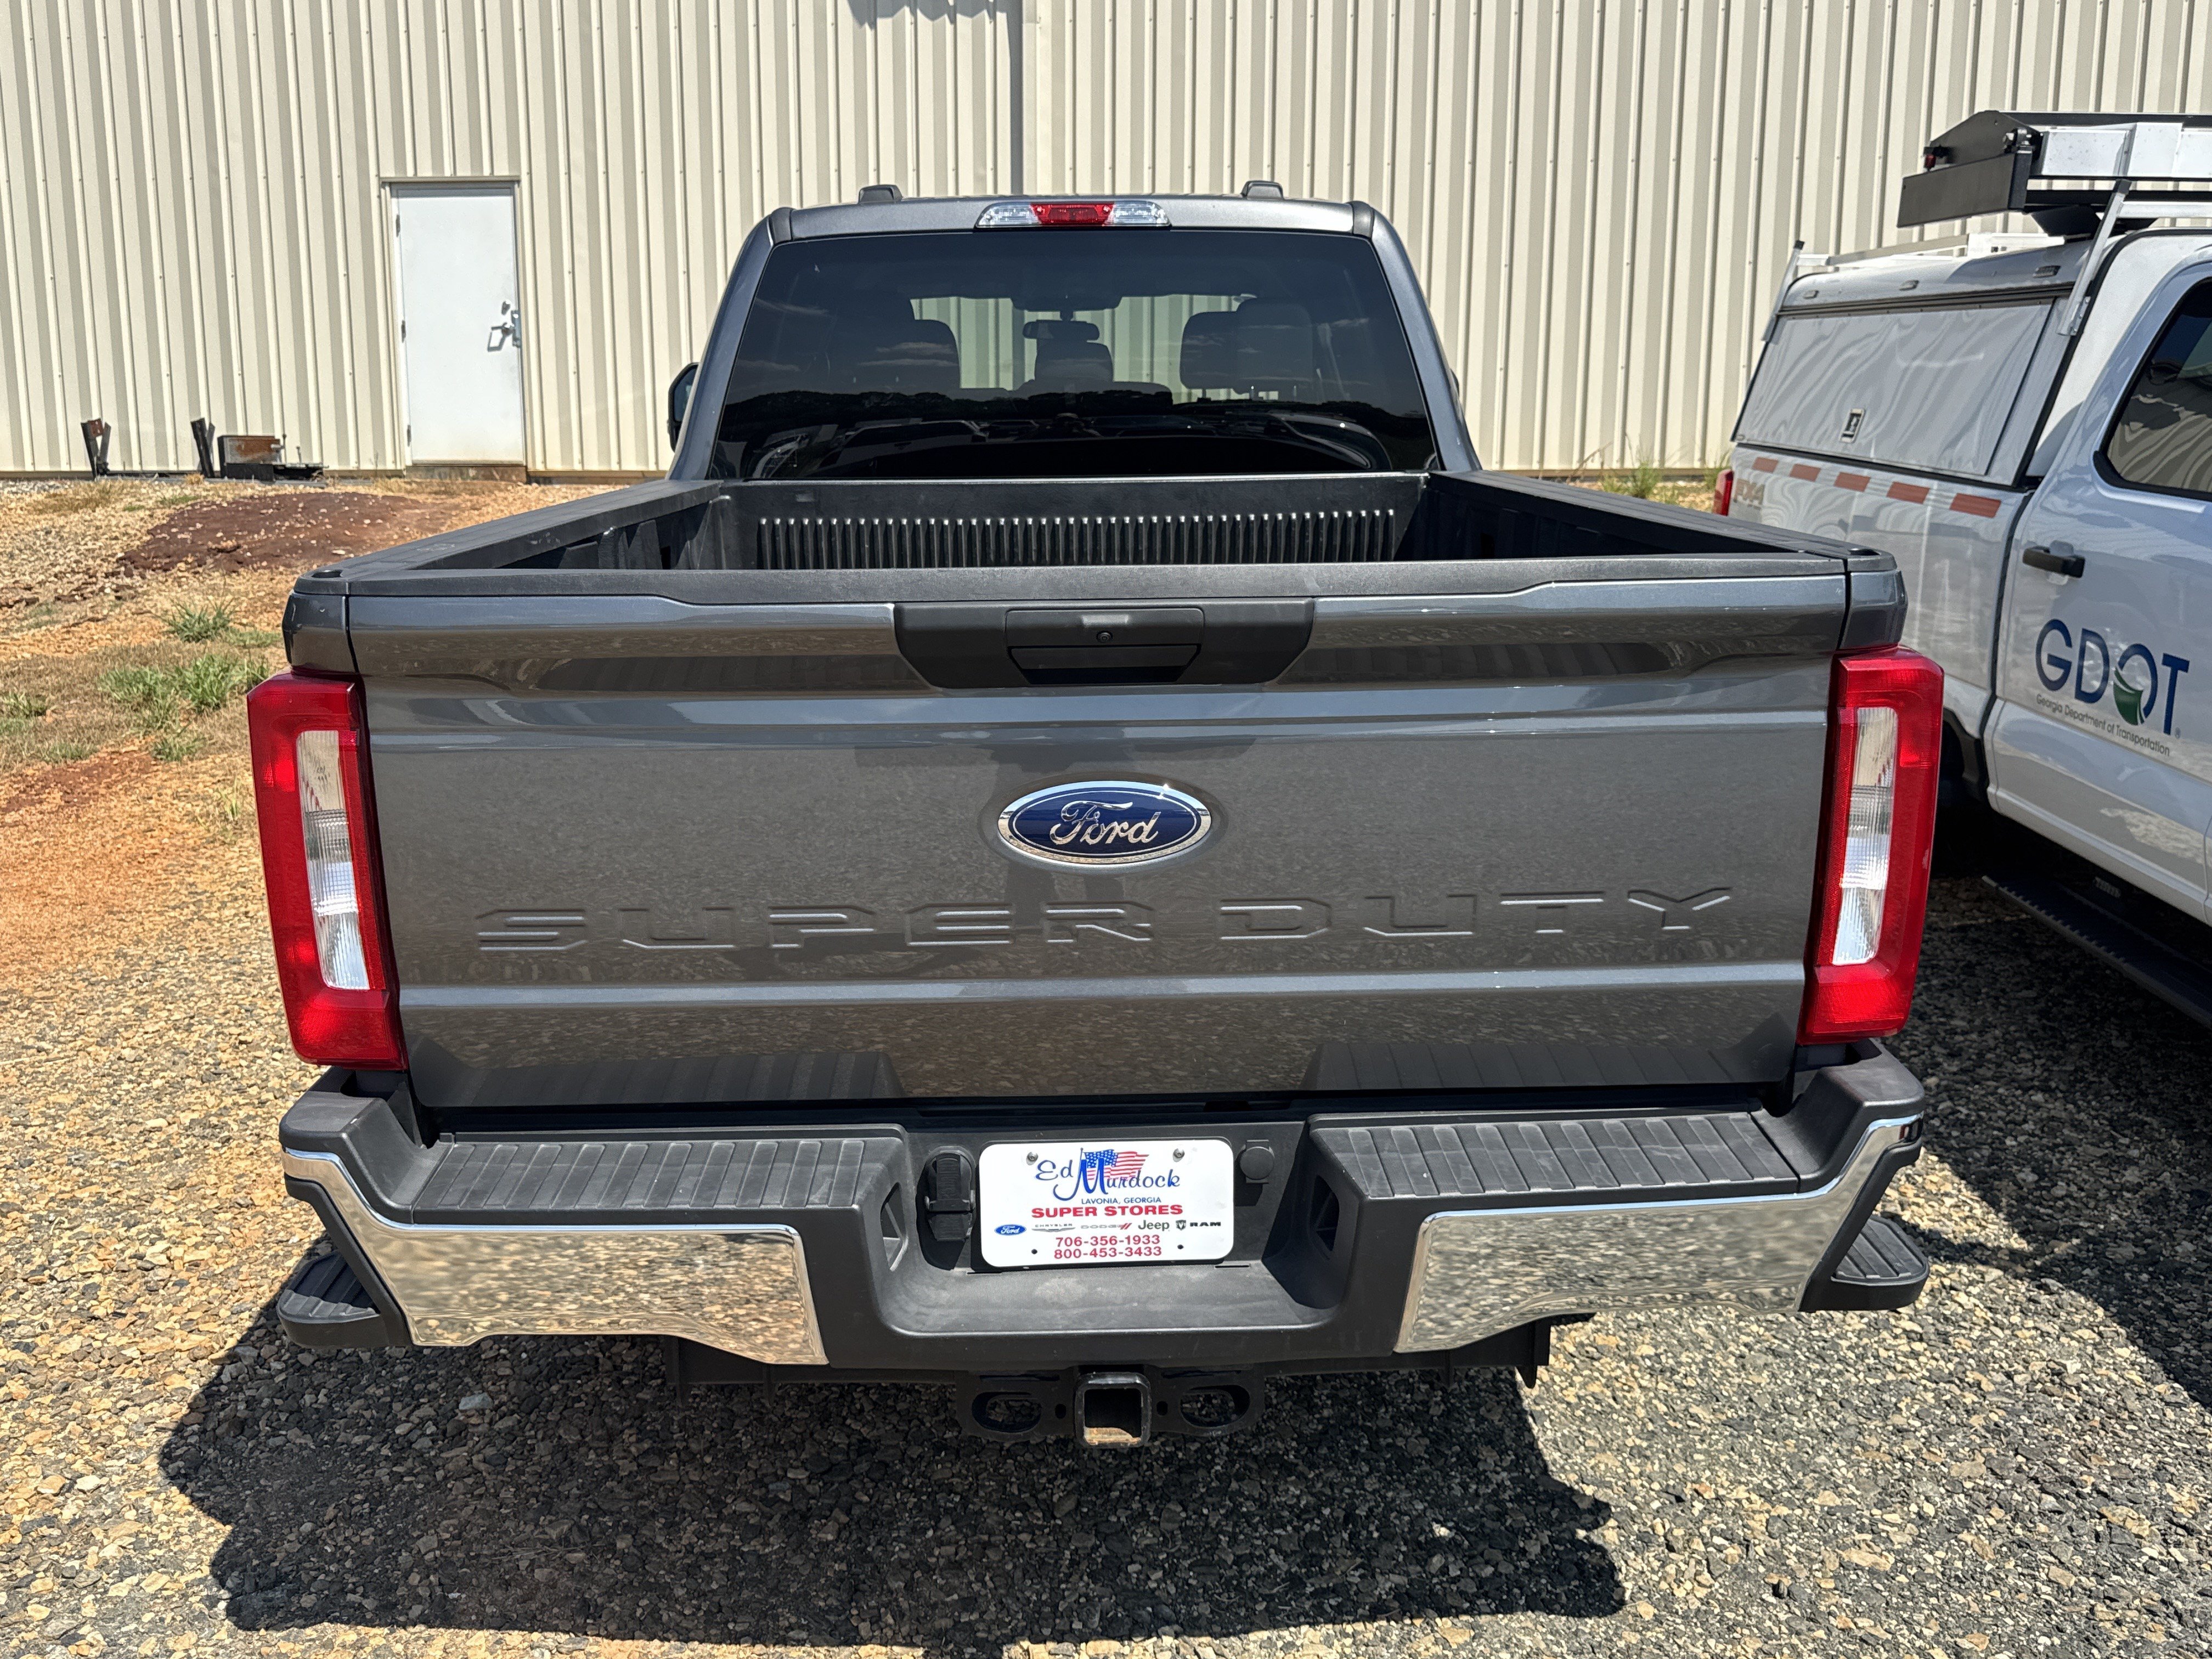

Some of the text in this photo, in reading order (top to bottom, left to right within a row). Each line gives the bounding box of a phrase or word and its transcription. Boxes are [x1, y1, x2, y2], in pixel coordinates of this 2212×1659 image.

[2036, 619, 2190, 736] GDOT
[2036, 693, 2170, 757] Georgia Department of Transportation
[1049, 800, 1161, 845] Ford
[476, 887, 1733, 951] SUPER DUTY
[1035, 1157, 1181, 1201] Ed Murdock
[1000, 1225, 1020, 1234] Ford
[1138, 1220, 1170, 1232] Jeep
[1031, 1204, 1183, 1218] SUPER STORES
[1054, 1246, 1162, 1259] 800-453-3433
[1056, 1234, 1160, 1247] 706-356-1933
